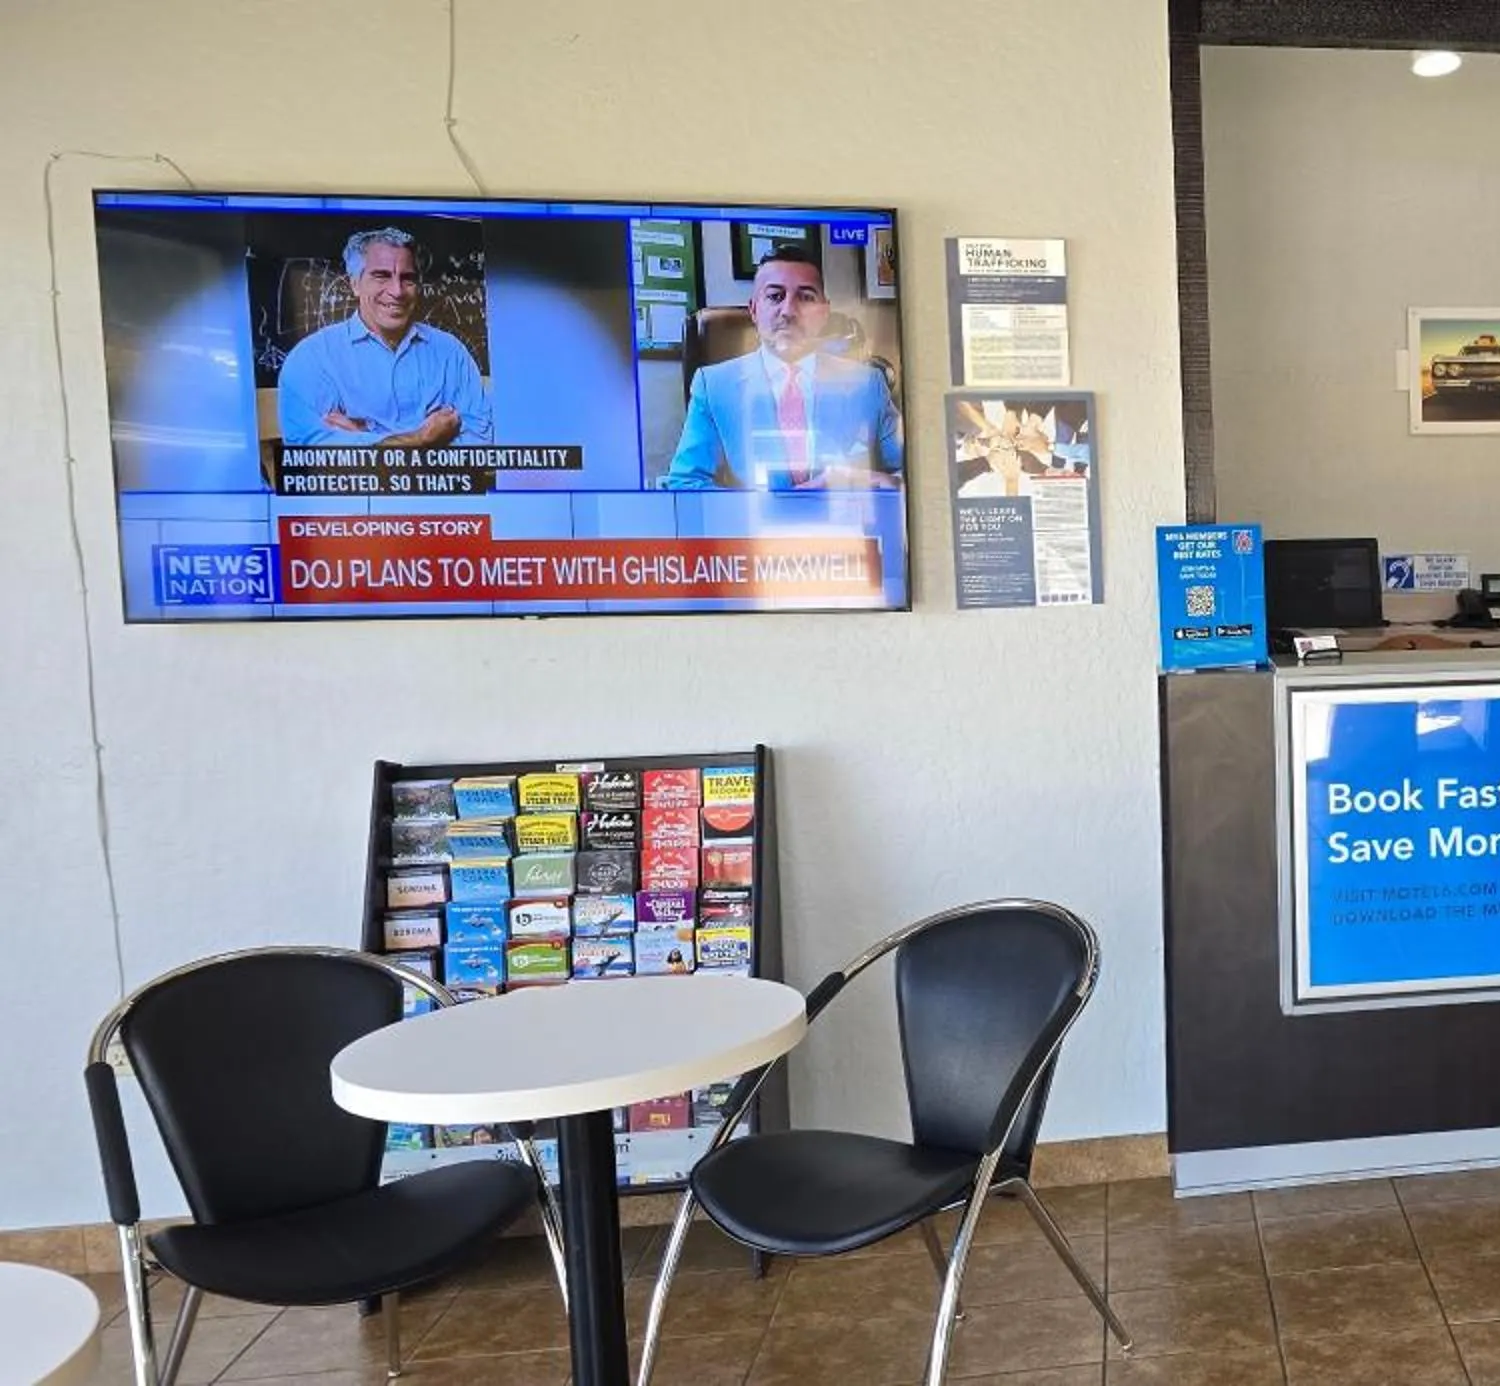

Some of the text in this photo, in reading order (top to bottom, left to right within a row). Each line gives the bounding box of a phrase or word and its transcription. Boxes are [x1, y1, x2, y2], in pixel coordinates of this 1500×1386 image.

[833, 229, 864, 241] LIVE
[965, 249, 1012, 258] HUMAN
[968, 258, 1047, 269] TRAFFICKING
[282, 449, 568, 467] ANONYMITY OR A CONFIDENTIALITY
[283, 474, 472, 492] PROTECTED. SO THAT'S
[290, 521, 483, 537] DEVELOPING STORY
[1178, 541, 1216, 550] GET OUR
[1195, 550, 1222, 559] RATES
[169, 555, 263, 576] NEWS
[291, 554, 868, 589] DOJ PLANS TO MEET WITH GHISLAINE MAXWELL
[169, 578, 265, 596] NATION
[1328, 778, 1423, 815] Book
[1328, 831, 1414, 863] Save
[1334, 888, 1375, 903] VISIT
[1383, 882, 1497, 900] MOTEL6.COM
[1333, 906, 1437, 925] DOWNLOAD
[1445, 904, 1474, 918] THE
